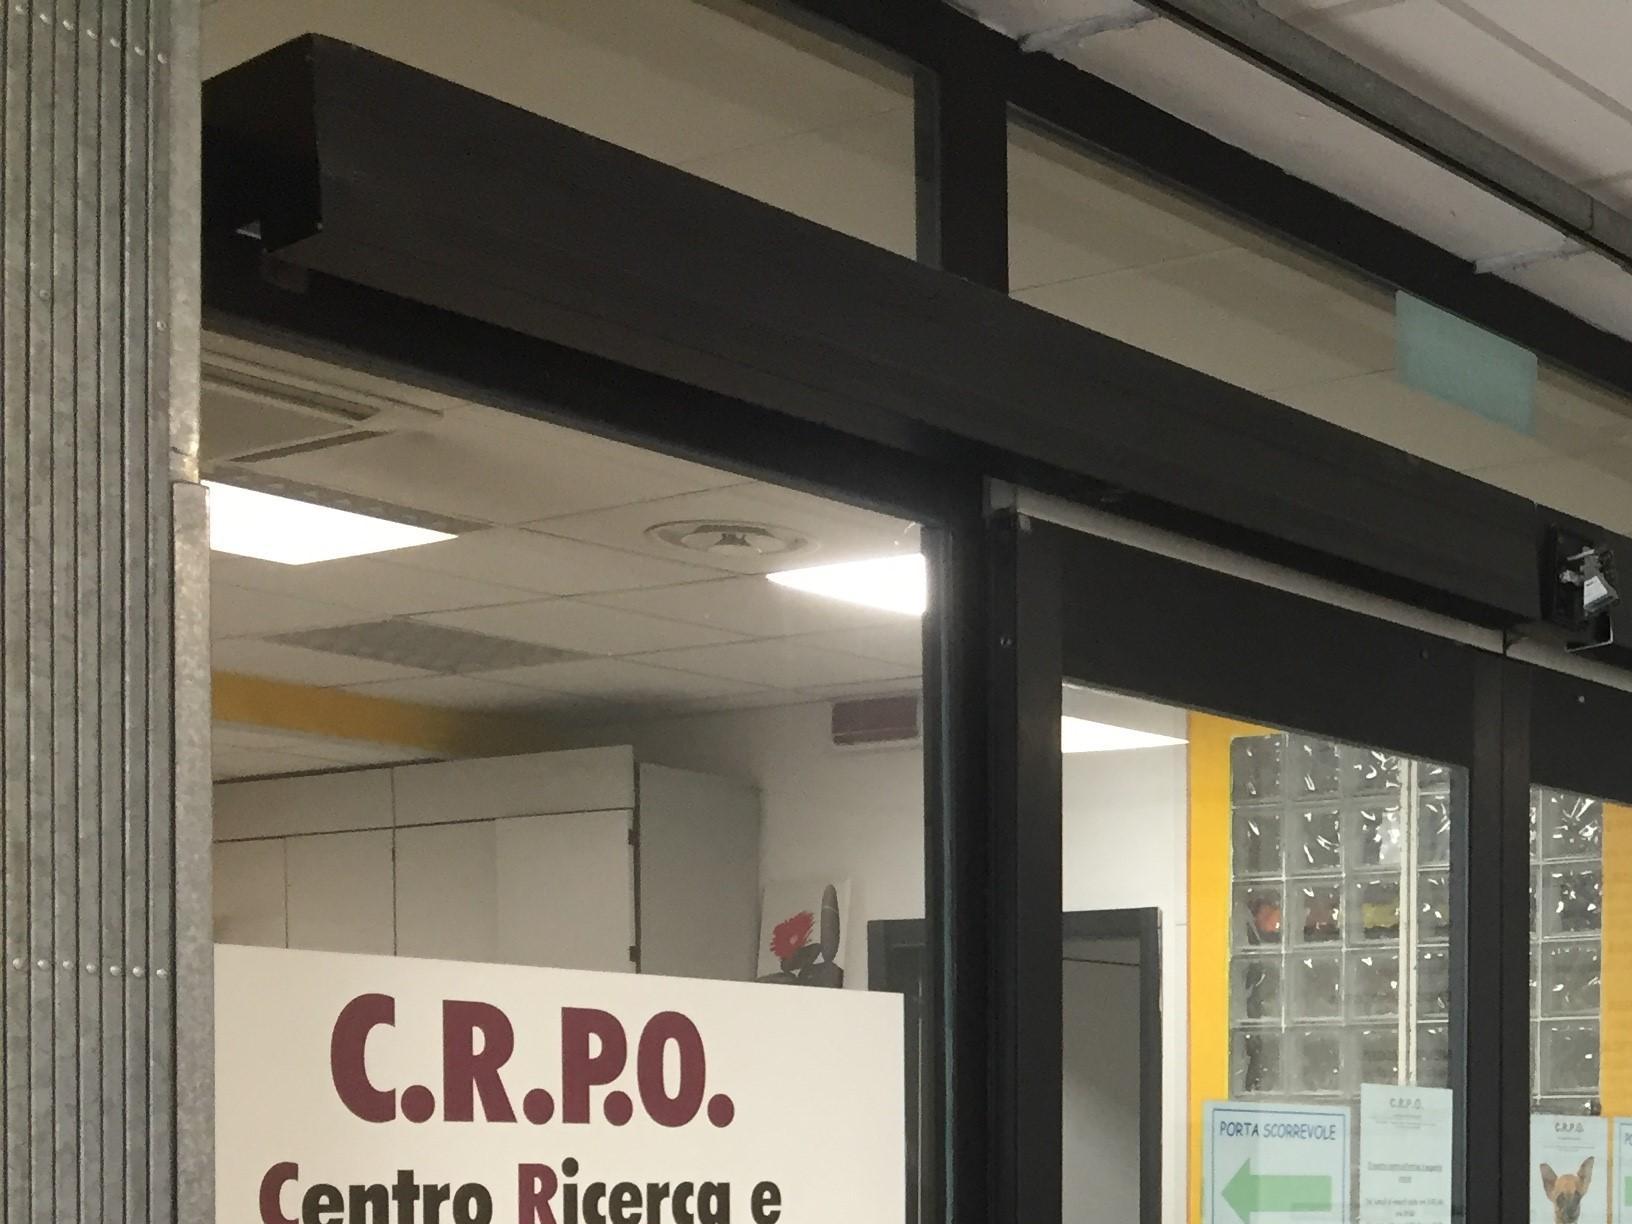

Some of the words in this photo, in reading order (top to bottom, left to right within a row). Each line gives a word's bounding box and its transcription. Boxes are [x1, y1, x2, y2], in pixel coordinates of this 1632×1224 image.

[331, 993, 735, 1128] C.R.P.O.
[1220, 1120, 1259, 1139] PORTA
[1263, 1123, 1336, 1141] SCORREVOLE
